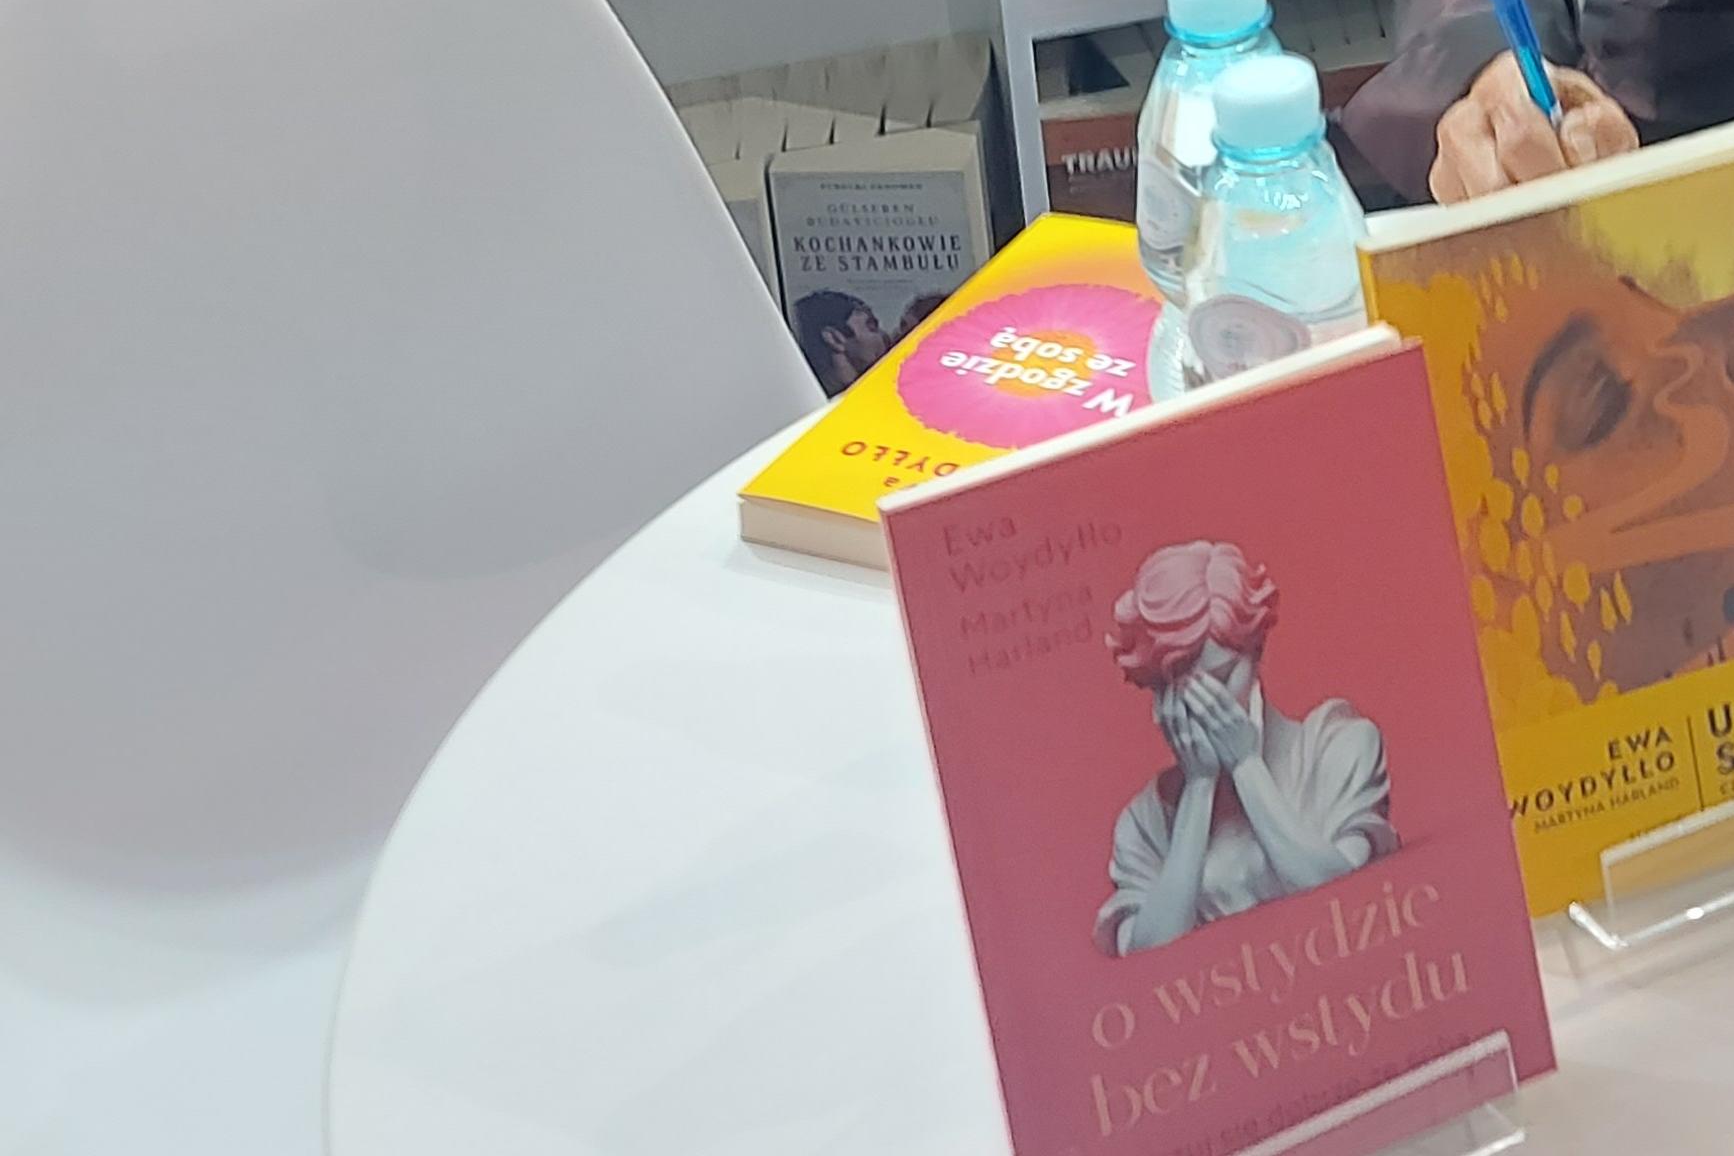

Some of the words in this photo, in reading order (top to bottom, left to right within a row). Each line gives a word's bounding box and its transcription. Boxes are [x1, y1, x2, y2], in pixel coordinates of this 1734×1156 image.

[793, 233, 962, 254] KOCHANKOWIE
[800, 255, 827, 273] ZE
[988, 325, 1085, 365] sobą
[939, 349, 1095, 398] zgodzie
[1085, 352, 1137, 378] ze
[1082, 387, 1135, 419] W
[840, 440, 962, 479] DYŁŁO
[943, 516, 1018, 558] Ewa
[1607, 725, 1673, 761] EWA
[1091, 1001, 1136, 1048] o
[1154, 880, 1441, 1026] wstydzie
[1090, 1053, 1218, 1137] bez
[1232, 950, 1470, 1079] wstydu
